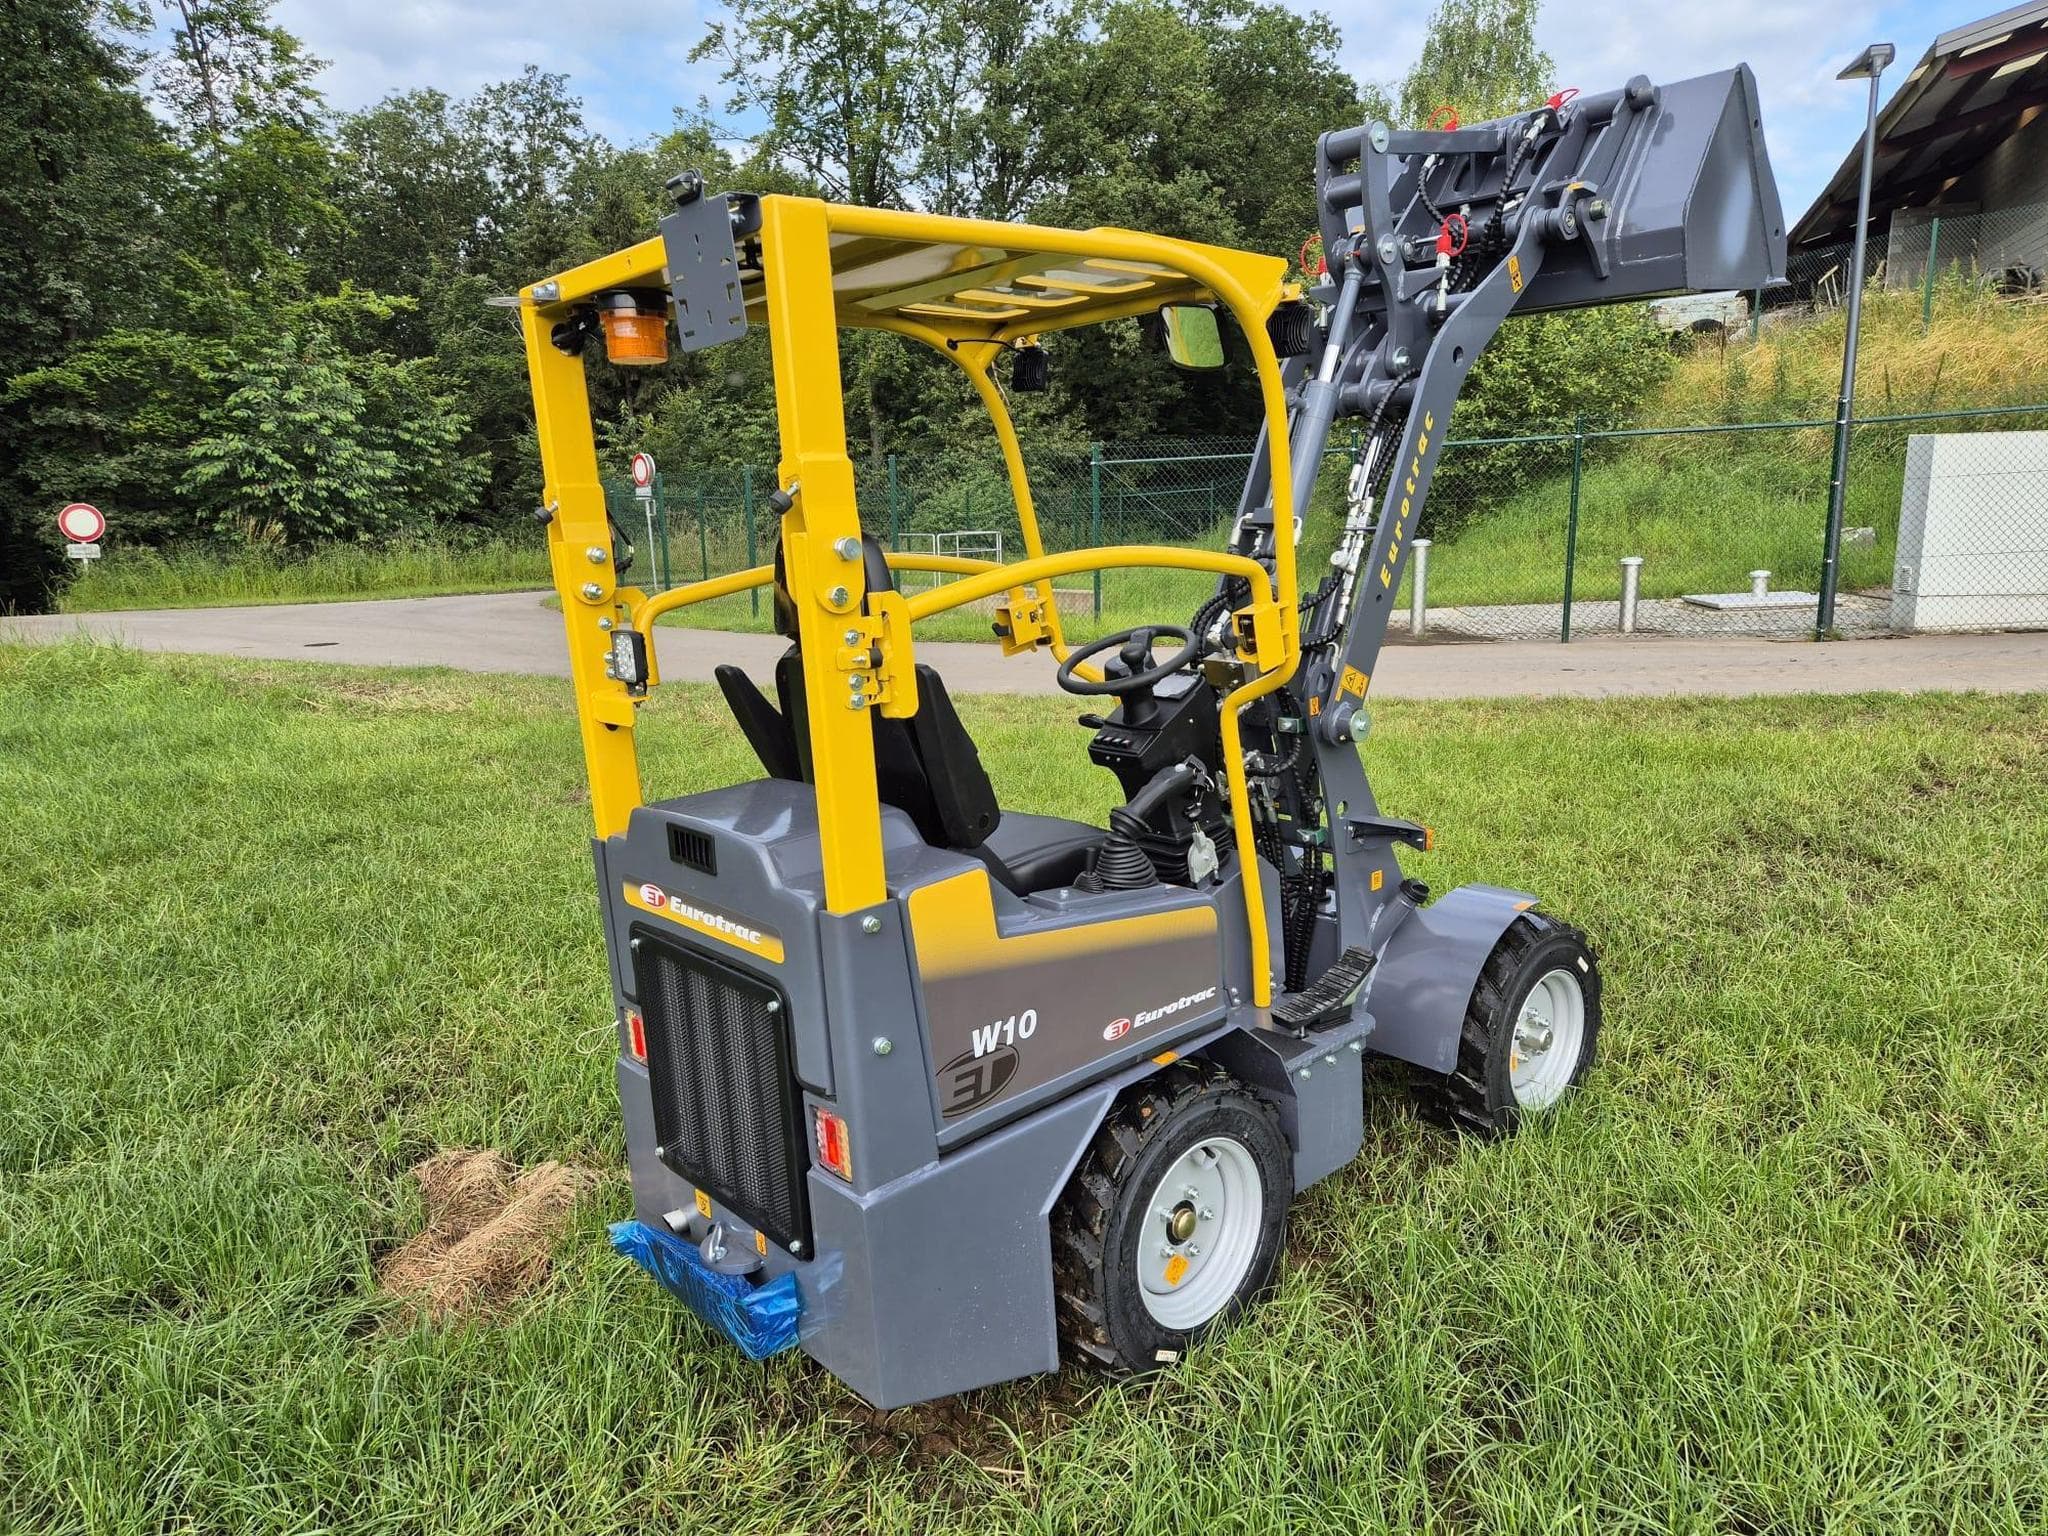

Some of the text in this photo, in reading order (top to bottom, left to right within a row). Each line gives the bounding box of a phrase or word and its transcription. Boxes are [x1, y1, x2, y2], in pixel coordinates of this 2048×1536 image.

[1380, 410, 1434, 589] Eurotrac
[640, 884, 761, 945] ET Eurotrac
[972, 1009, 1037, 1058] W10
[1103, 986, 1216, 1040] ET Eurotrac
